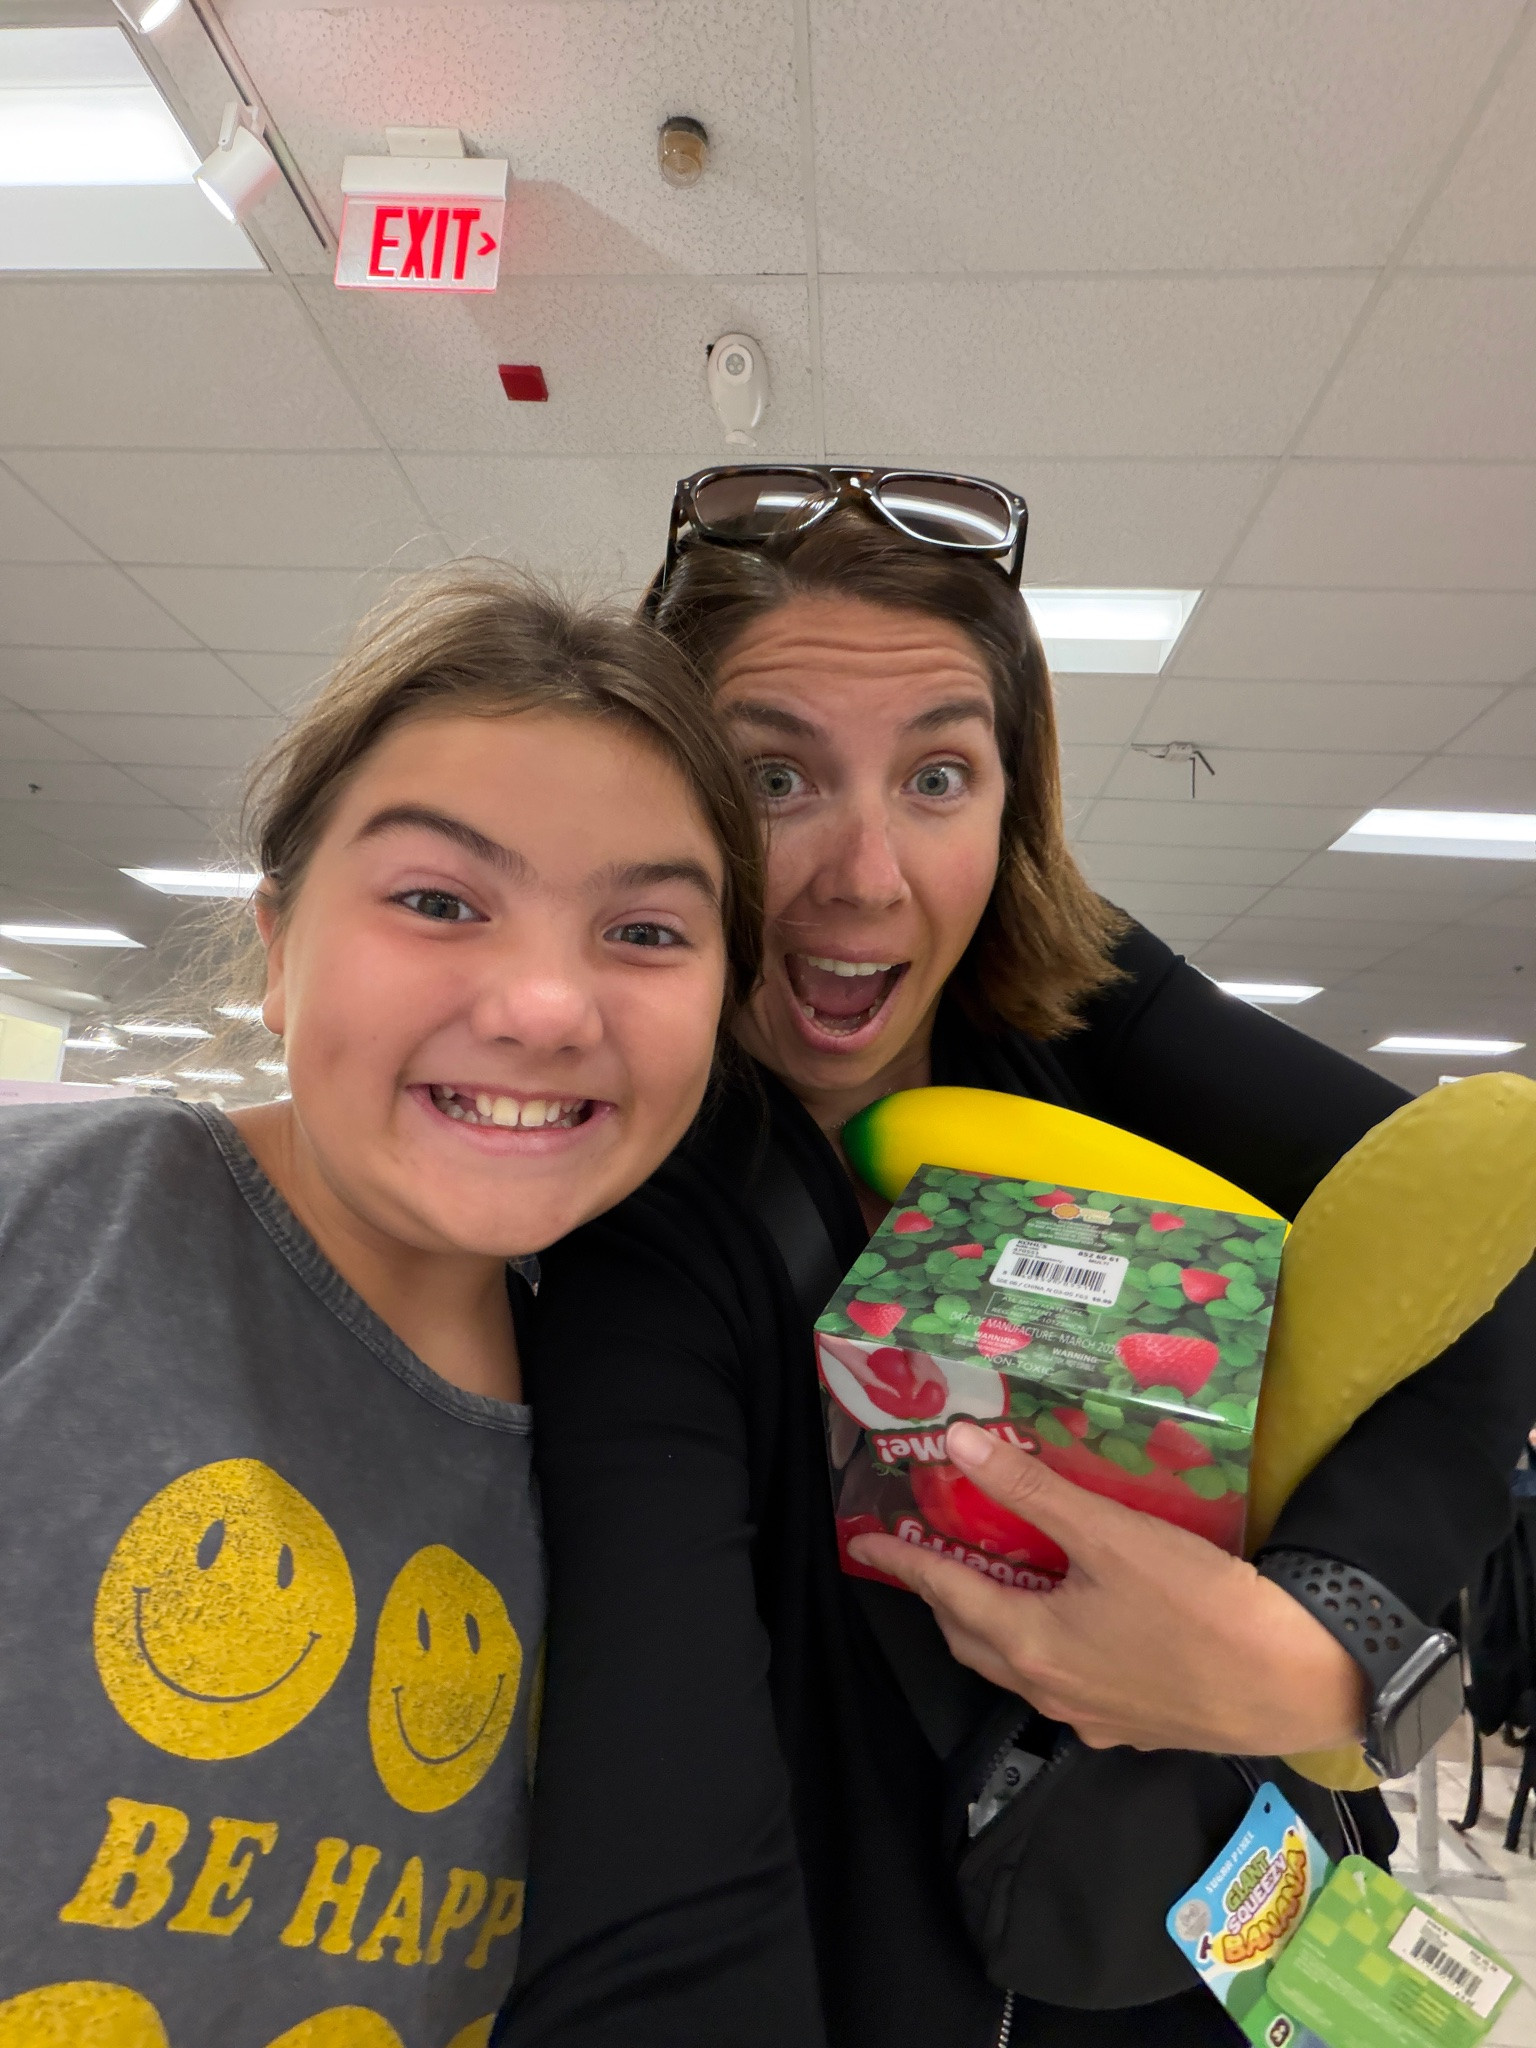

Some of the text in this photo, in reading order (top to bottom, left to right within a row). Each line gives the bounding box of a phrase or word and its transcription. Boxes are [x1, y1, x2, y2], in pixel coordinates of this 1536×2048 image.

[367, 205, 481, 280] EXIT
[1018, 1240, 1048, 1250] KOHL'S
[950, 1311, 972, 1324] DATE
[973, 1316, 986, 1326] OF
[1059, 1333, 1096, 1348] MARCH
[984, 1354, 1055, 1375] NON-TOXIC
[876, 1434, 947, 1463] Me!
[897, 1520, 1056, 1592] wberry
[58, 1797, 279, 1936] BE
[1225, 1849, 1269, 1912] GIANT
[1226, 1851, 1288, 1936] SQUEEZY
[1221, 1849, 1306, 1964] BANANA
